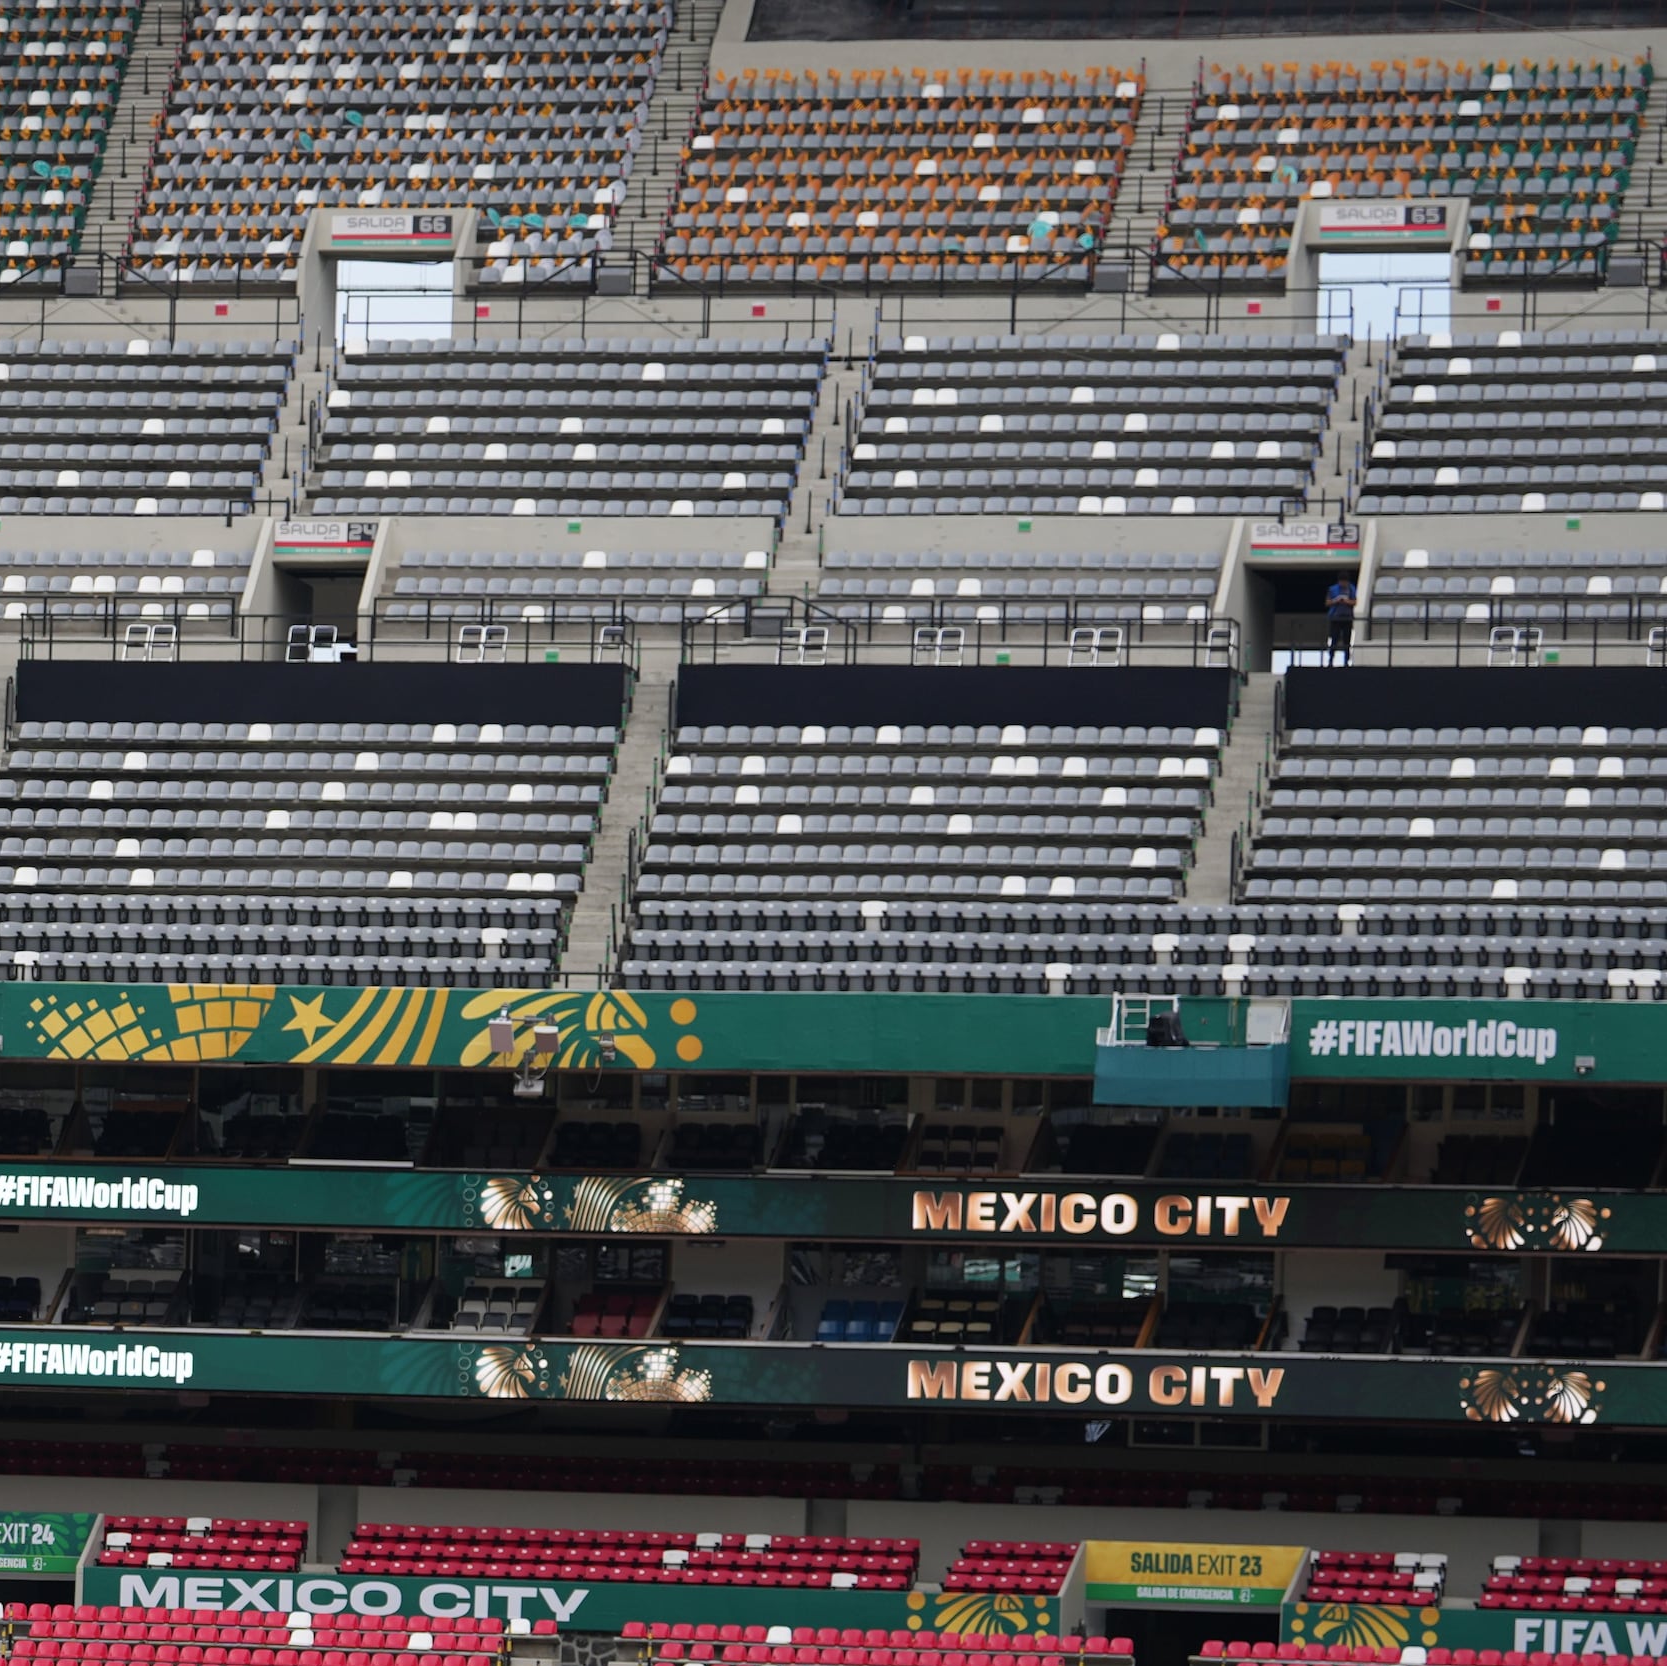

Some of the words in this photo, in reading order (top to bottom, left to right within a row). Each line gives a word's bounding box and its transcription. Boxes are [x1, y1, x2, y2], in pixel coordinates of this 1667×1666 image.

[347, 217, 406, 229] SALIDA
[419, 216, 445, 233] 66
[1336, 207, 1397, 221] SALIDA
[1411, 208, 1440, 224] 65
[279, 523, 340, 536] SALIDA
[348, 523, 378, 541] 24
[1256, 524, 1318, 537] SALIDA
[1329, 524, 1358, 543] 23
[1308, 1018, 1557, 1065] #FIFAWorldCup
[912, 1191, 1138, 1235] MEXICO
[1154, 1195, 1290, 1236] CITY
[906, 1359, 1134, 1404] MEXICO
[1148, 1364, 1285, 1408] CITY
[31, 1523, 56, 1546] 24
[1130, 1551, 1194, 1575] SALIDA
[1197, 1553, 1237, 1577] EXIT
[1239, 1555, 1262, 1578] 23
[119, 1574, 402, 1616] MEXICO
[419, 1582, 589, 1622] CITY
[1136, 1586, 1166, 1599] SALIDA
[1514, 1617, 1617, 1658] FIFA
